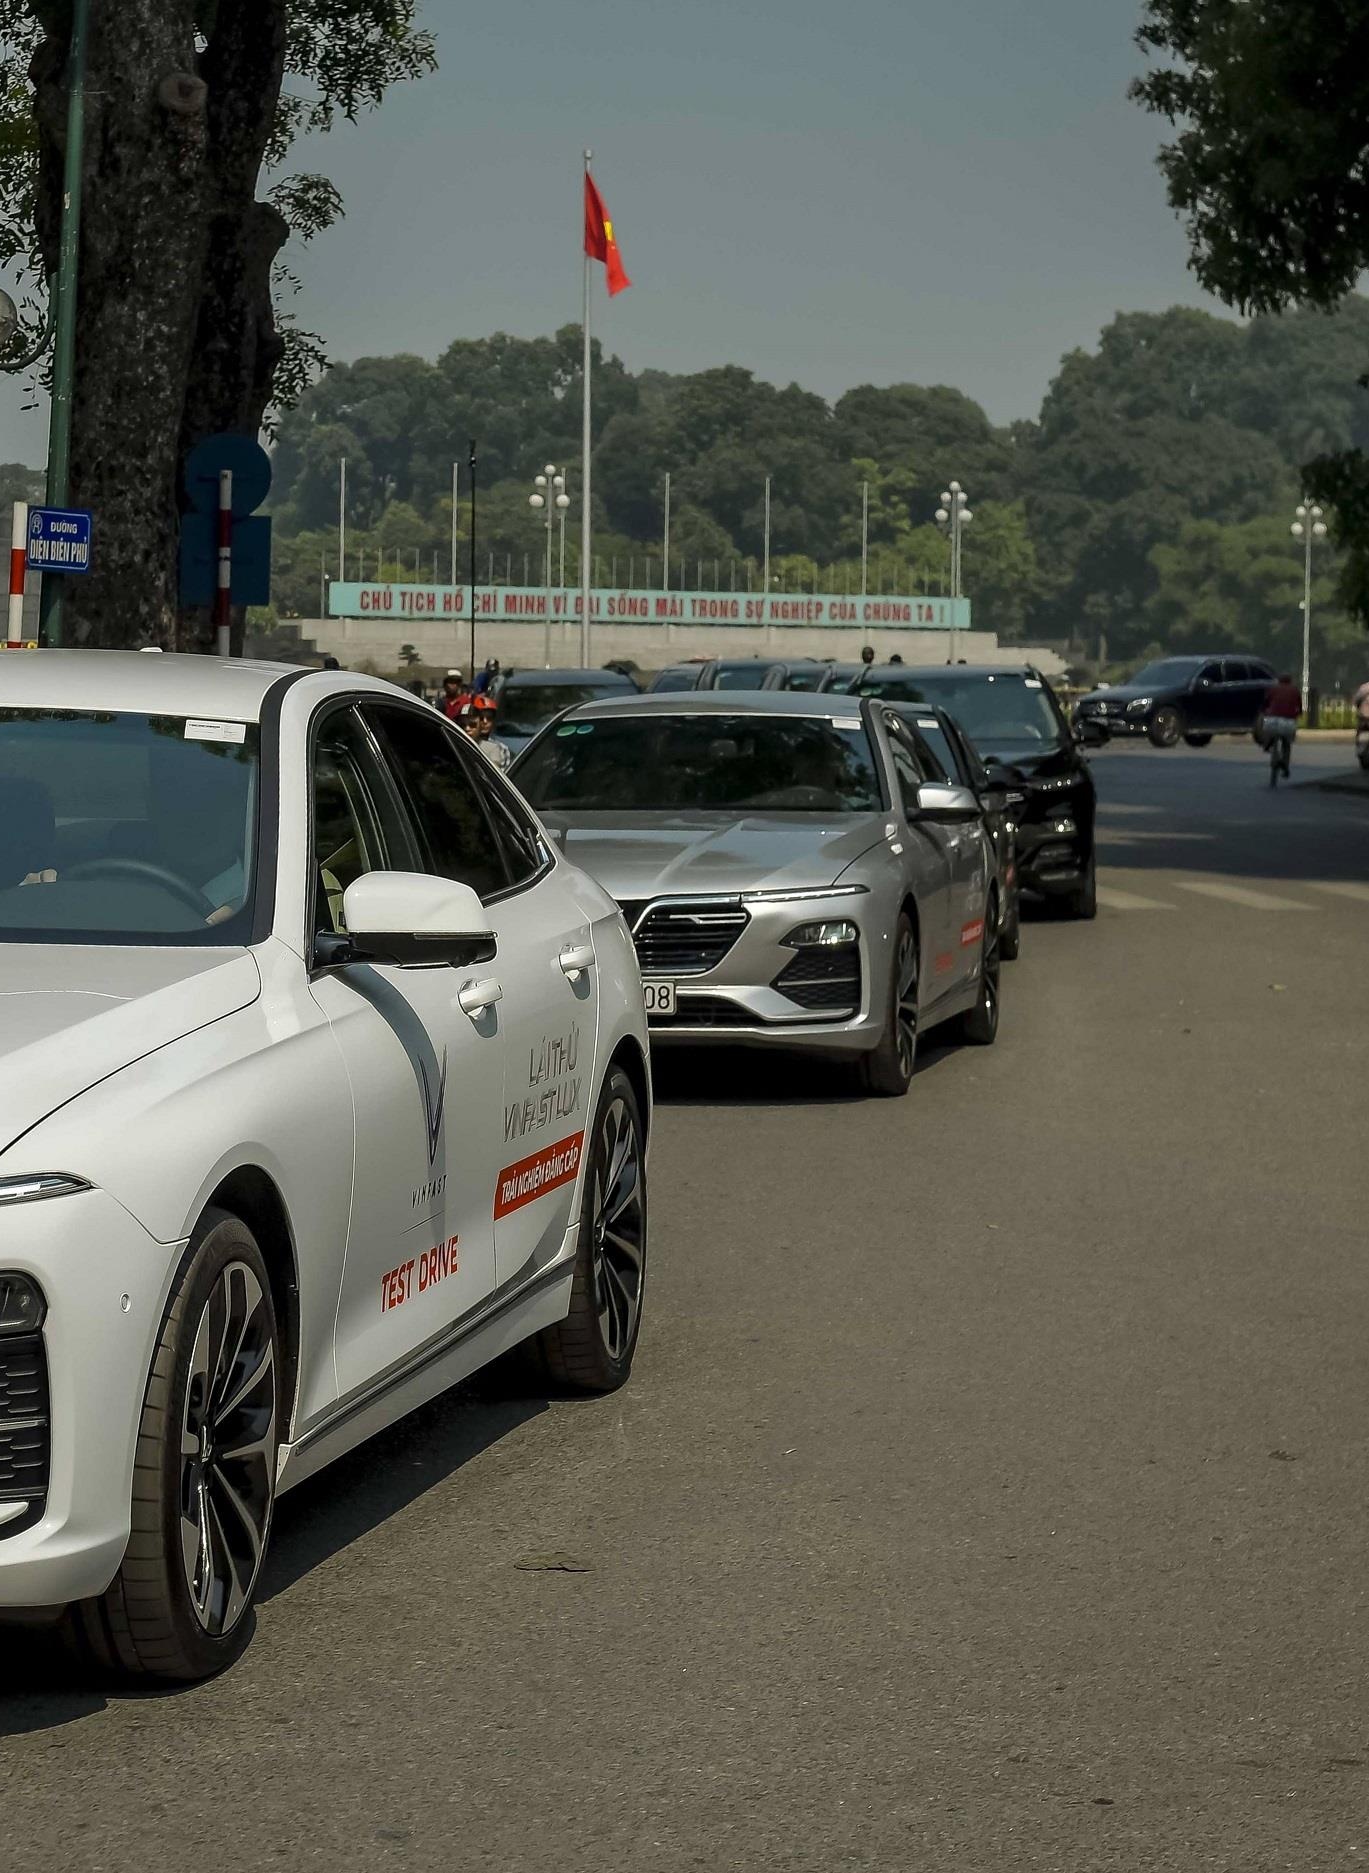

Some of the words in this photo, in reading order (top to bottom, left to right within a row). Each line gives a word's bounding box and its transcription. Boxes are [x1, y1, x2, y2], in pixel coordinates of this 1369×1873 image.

[360, 585, 392, 610] CHỦ
[400, 591, 436, 616] TỊCH
[443, 586, 464, 612] HỒ
[473, 589, 497, 613] CHÍ
[504, 593, 547, 615] MINH
[607, 592, 649, 617] SỐNG
[692, 599, 738, 619] TRONG
[770, 598, 823, 625] NGHIỆP
[828, 597, 857, 621] CỦA
[863, 600, 912, 622] CHÚNG
[917, 604, 935, 622] TA
[381, 1259, 415, 1313] TEST
[418, 1235, 459, 1293] DRIVE
